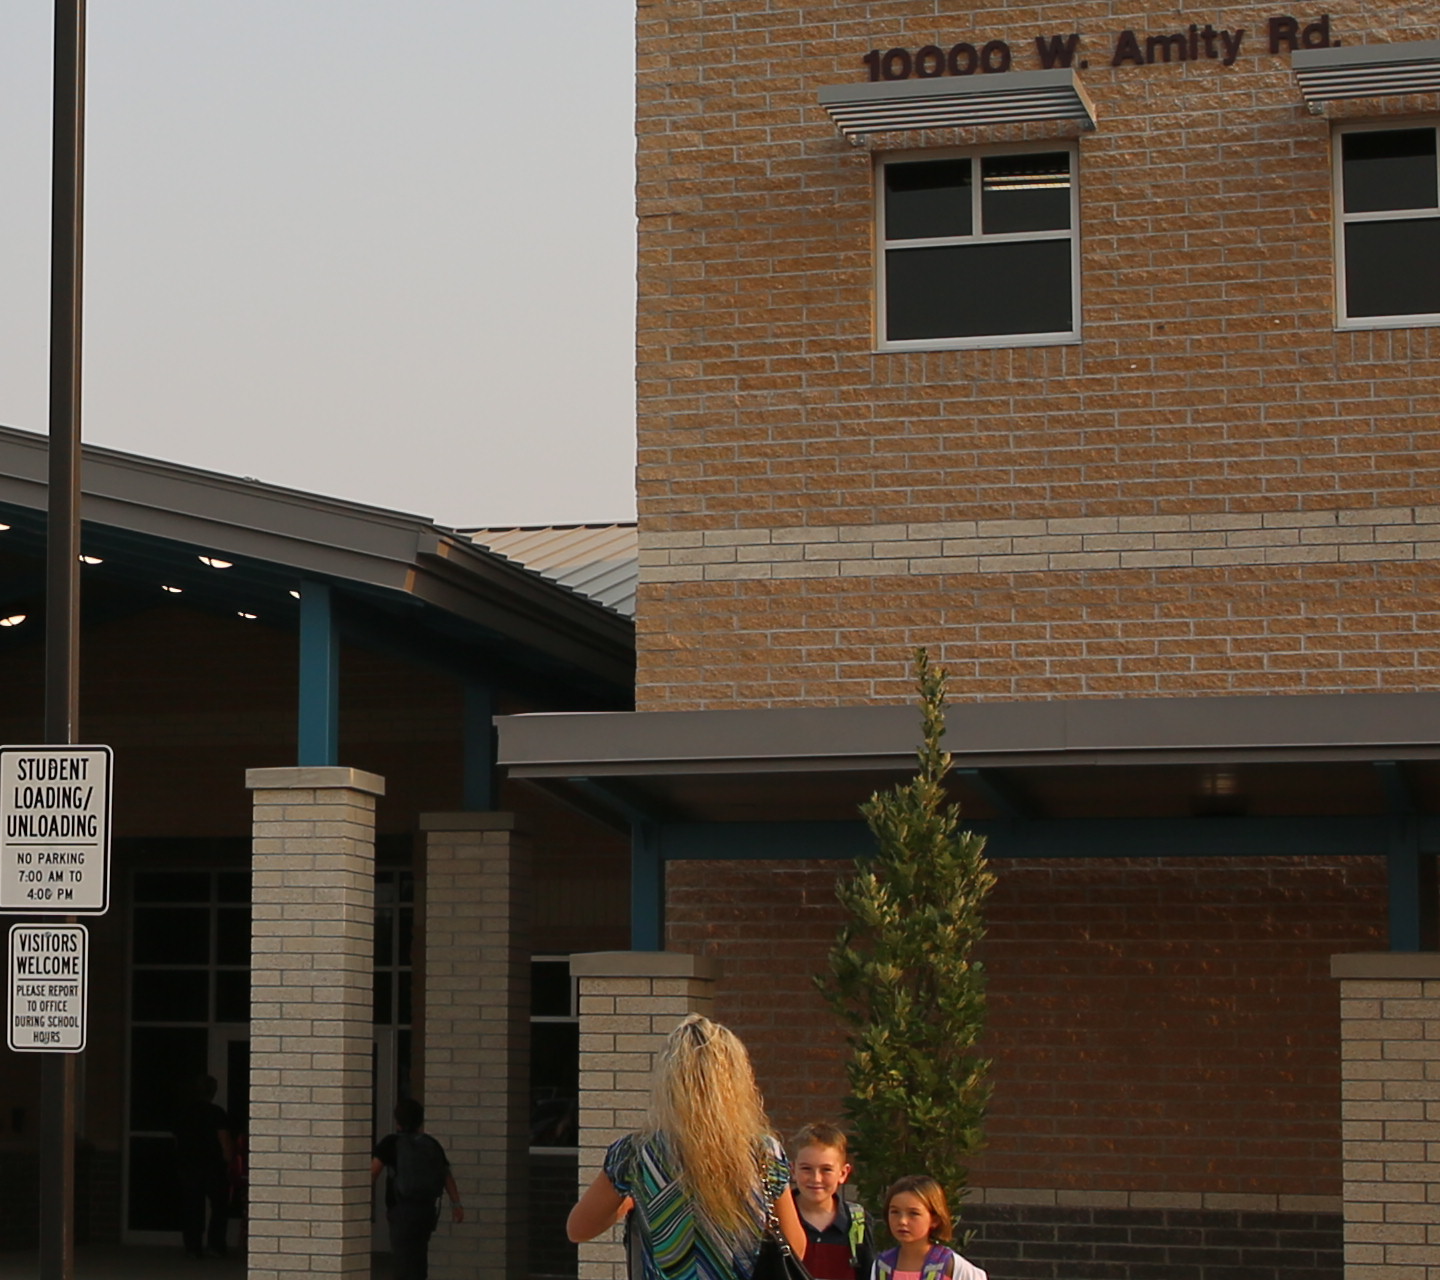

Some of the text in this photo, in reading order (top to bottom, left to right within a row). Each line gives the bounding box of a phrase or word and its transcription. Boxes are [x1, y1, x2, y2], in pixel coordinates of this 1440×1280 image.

[863, 14, 1341, 82] 10000 W. Amity Rd.
[17, 758, 89, 781] STUDENT
[14, 786, 93, 811] LOADING/
[7, 815, 97, 838] UNLOADING
[17, 852, 85, 865] NO PARKING
[18, 870, 82, 883] 7:00 AM TO
[27, 888, 73, 901] 4:00 PM
[19, 933, 77, 953] VISITORS
[16, 956, 80, 975] WELCOME
[16, 985, 79, 997] PLEASE REPORT
[27, 1000, 68, 1012] TO OFFICE
[15, 1015, 80, 1028] DURING SCHOOL
[33, 1031, 61, 1044] HOURS
